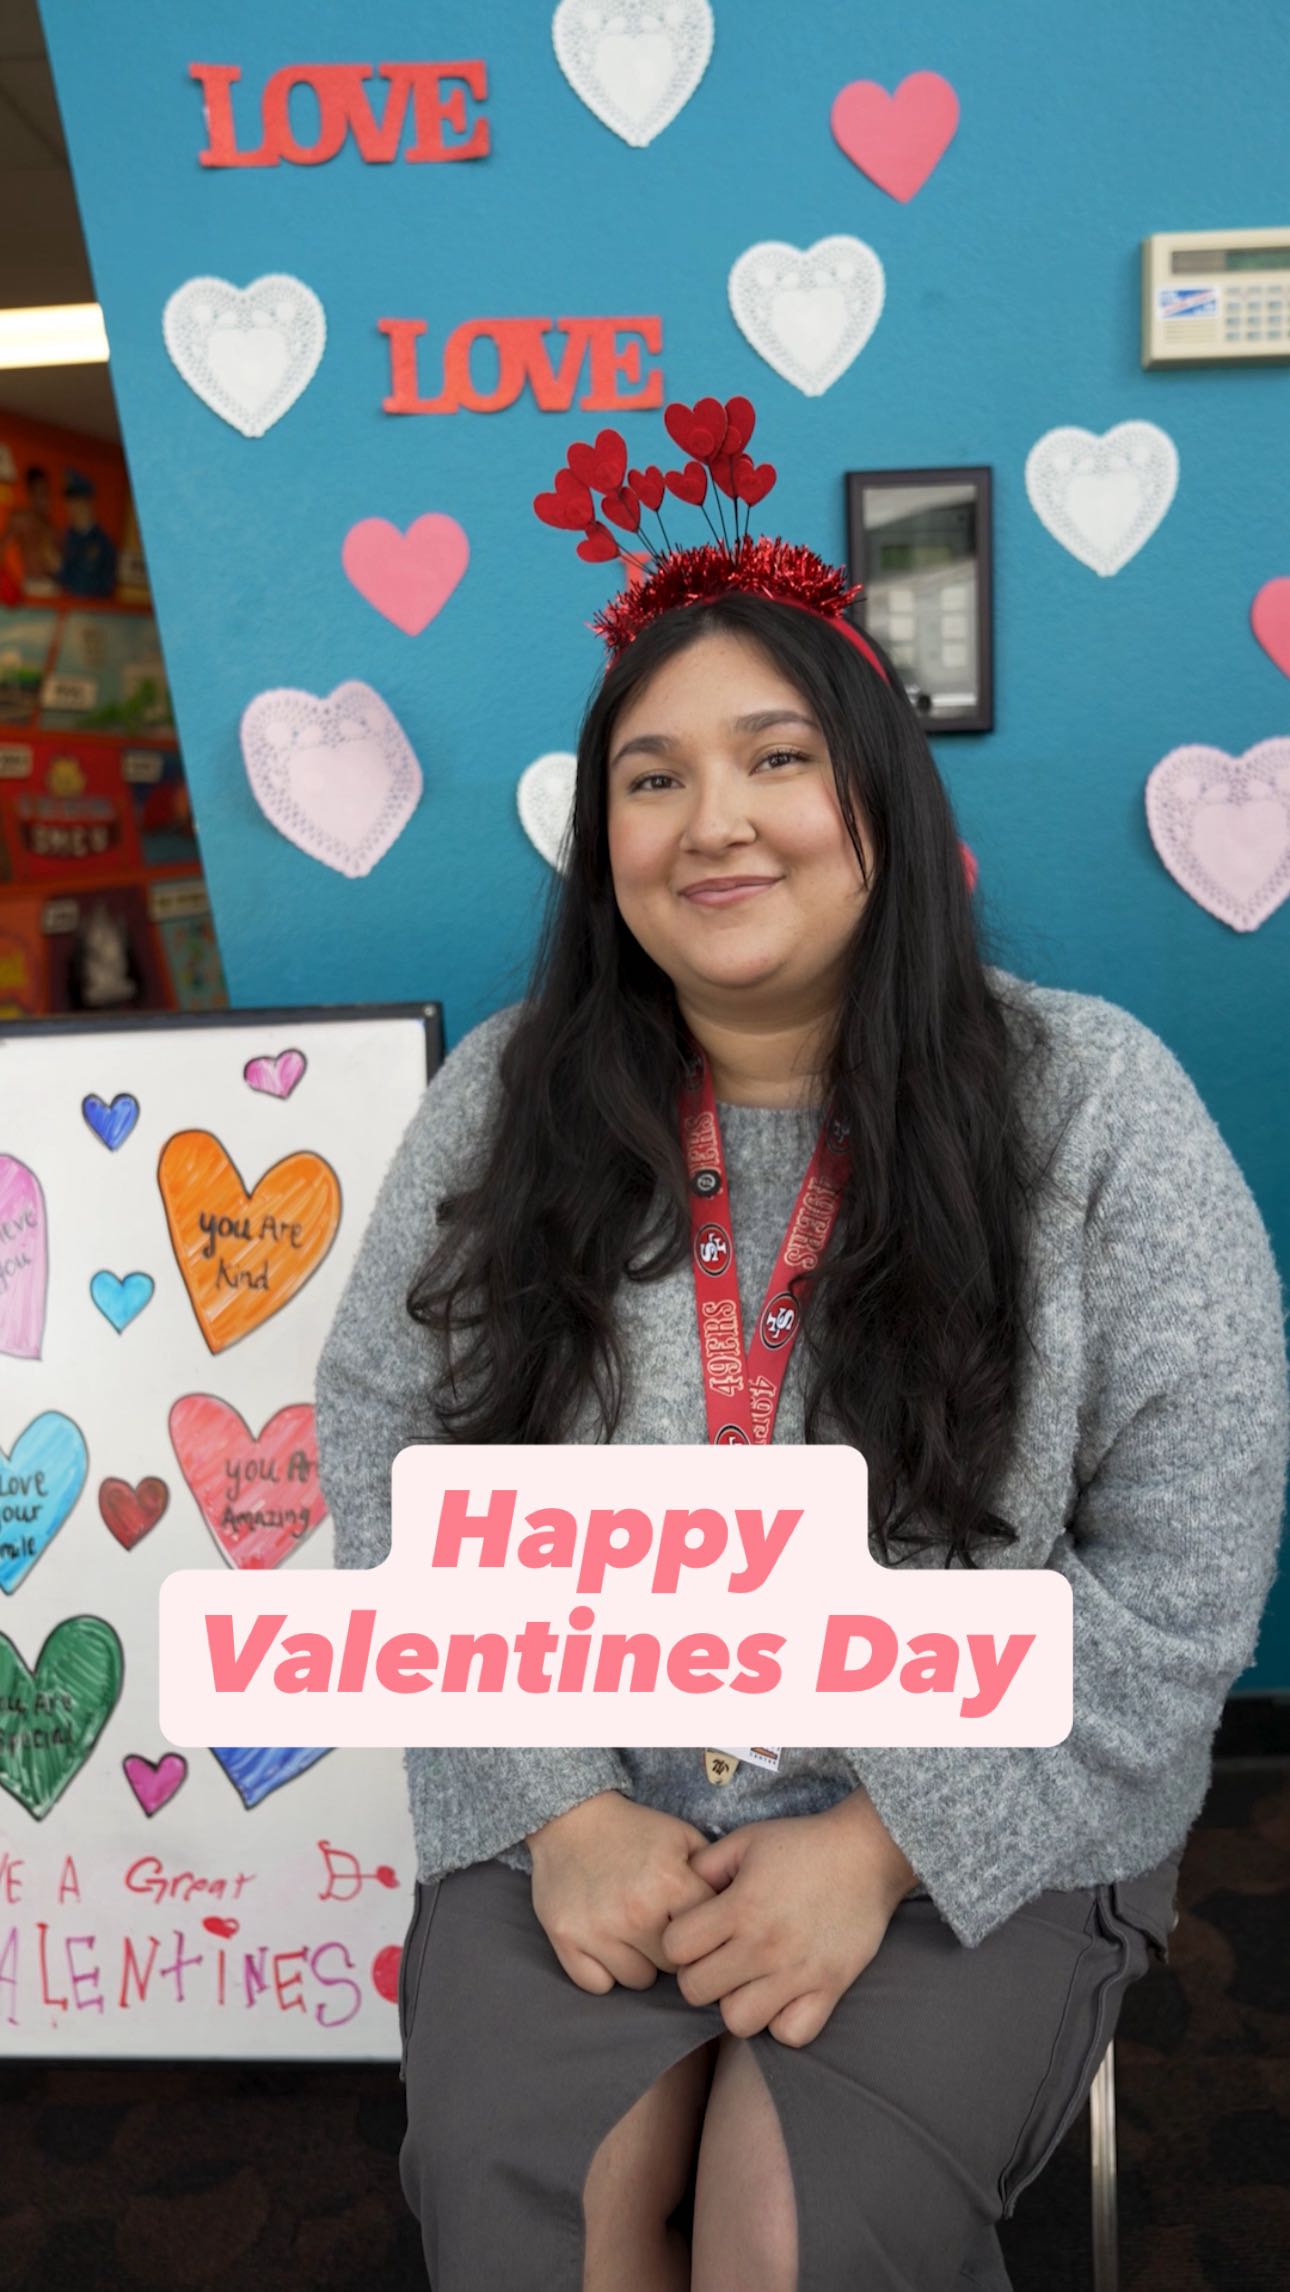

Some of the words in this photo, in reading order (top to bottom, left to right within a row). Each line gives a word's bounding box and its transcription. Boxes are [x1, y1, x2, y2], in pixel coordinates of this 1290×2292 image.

[189, 60, 490, 169] LOVE
[378, 316, 665, 415] LOVE
[198, 1210, 252, 1259] you
[258, 1214, 303, 1249] Are
[702, 1299, 745, 1398] 49ERS
[224, 1458, 281, 1502] you
[0, 1503, 43, 1523] our
[221, 1505, 310, 1539] Amazing
[59, 1855, 80, 1904] A
[124, 1856, 256, 1904] Great
